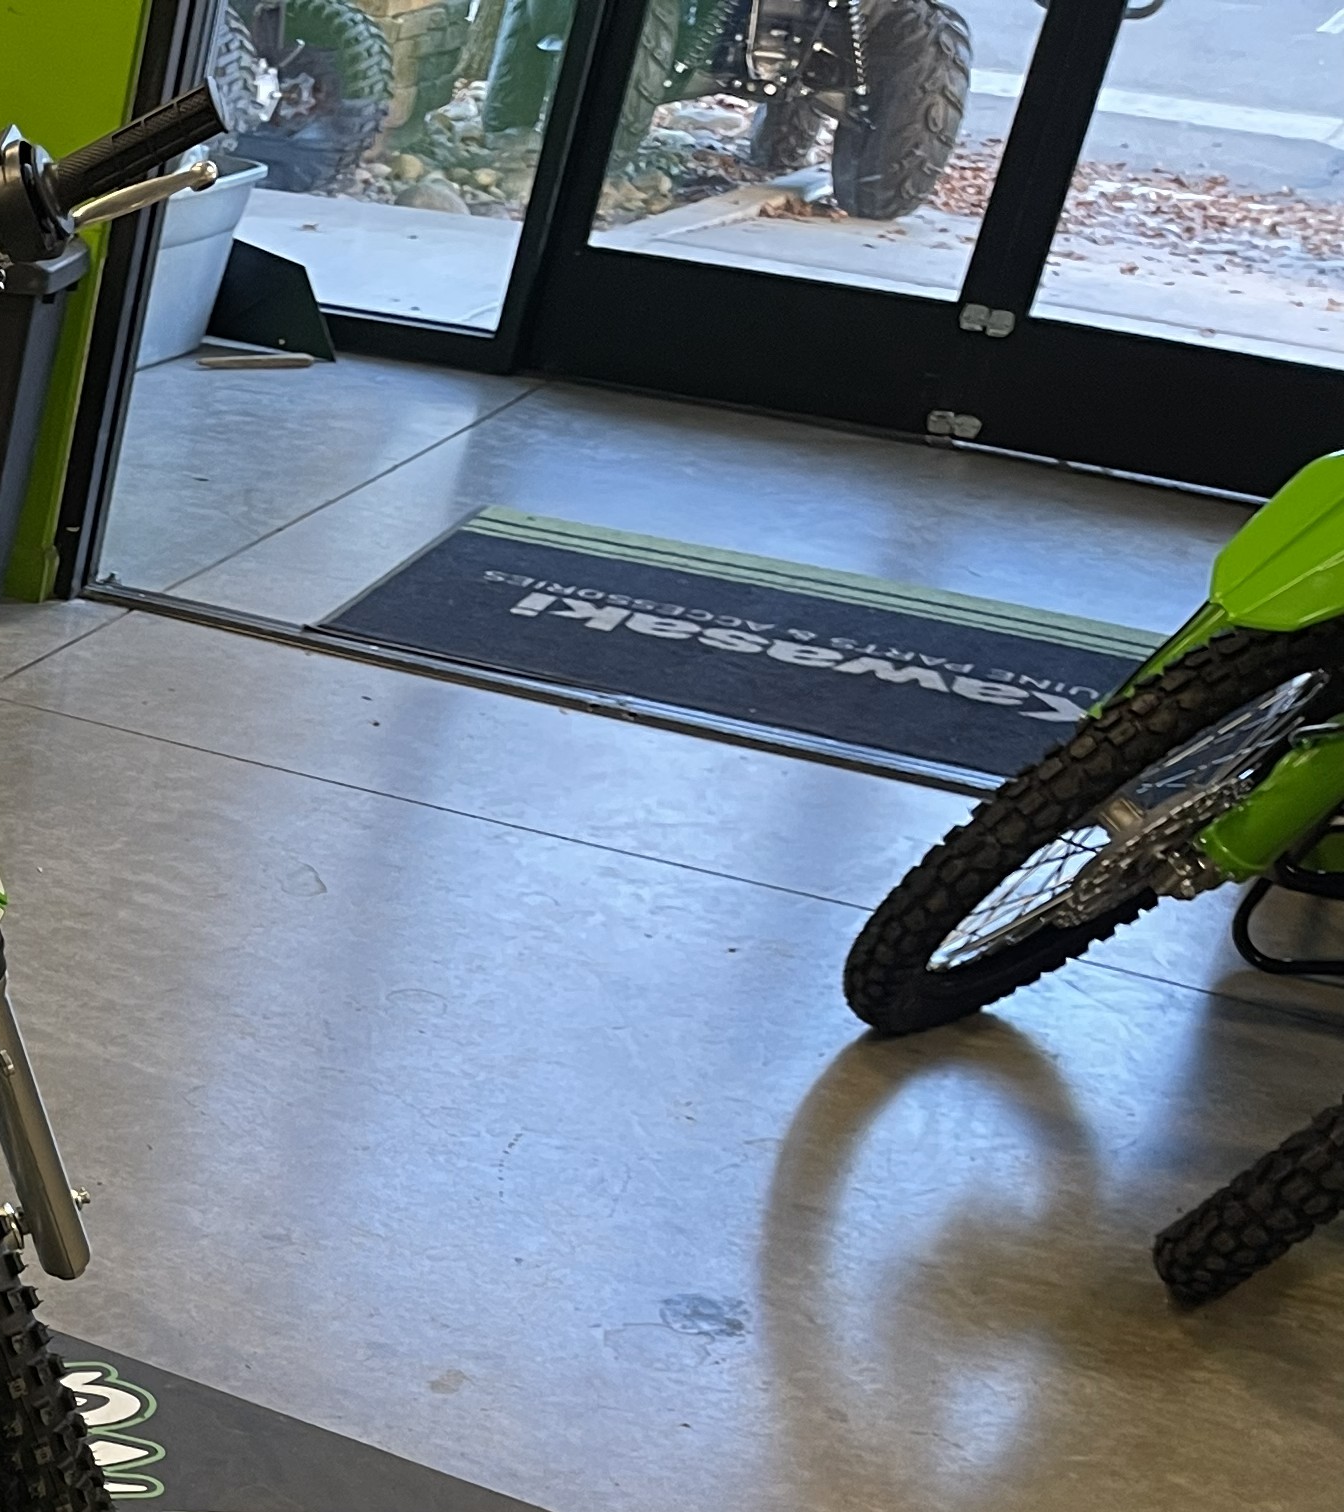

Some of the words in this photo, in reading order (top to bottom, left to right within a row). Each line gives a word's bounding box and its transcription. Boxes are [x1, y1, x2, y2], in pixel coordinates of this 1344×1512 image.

[483, 570, 775, 632] ACCESSORIES
[788, 628, 817, 641] &
[830, 637, 975, 674] PARTS
[987, 668, 1100, 700] UINE
